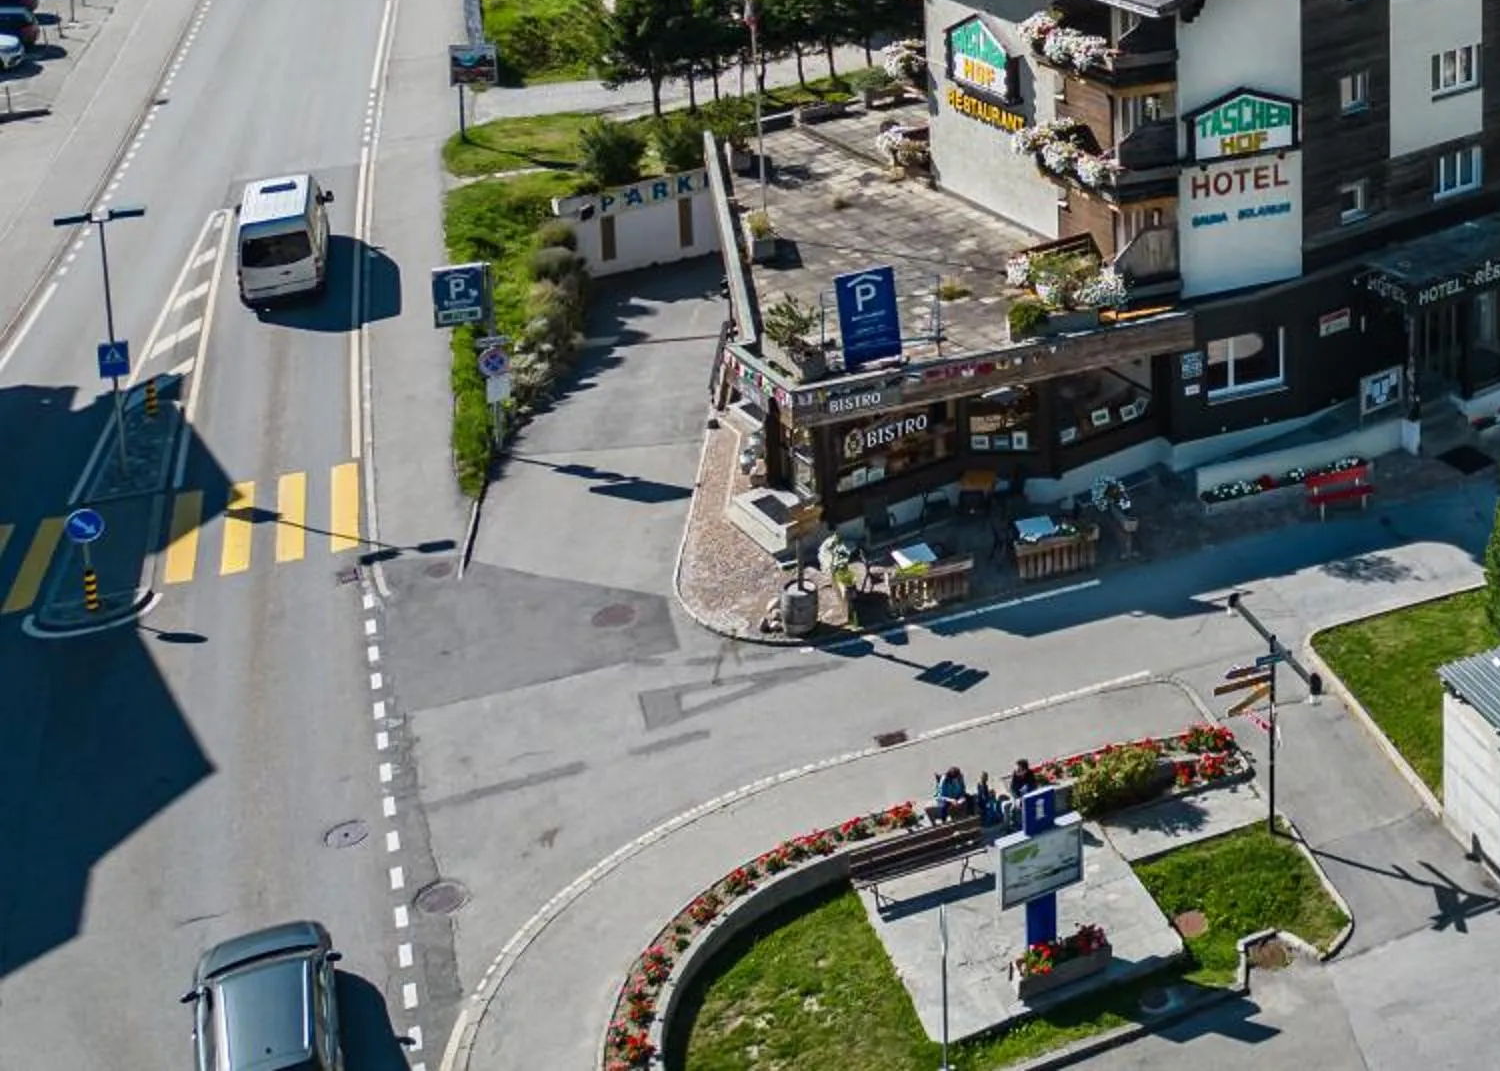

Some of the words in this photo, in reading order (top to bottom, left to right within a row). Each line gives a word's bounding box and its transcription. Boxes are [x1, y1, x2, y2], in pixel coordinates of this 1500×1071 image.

[948, 89, 1024, 131] RESTAURANT
[1221, 131, 1268, 155] HOF
[1191, 163, 1289, 199] HOTEL
[449, 278, 465, 300] P
[855, 282, 877, 312] P
[1419, 278, 1465, 306] HOTEL
[829, 391, 882, 414] BISTRO
[867, 414, 928, 449] BISTRO
